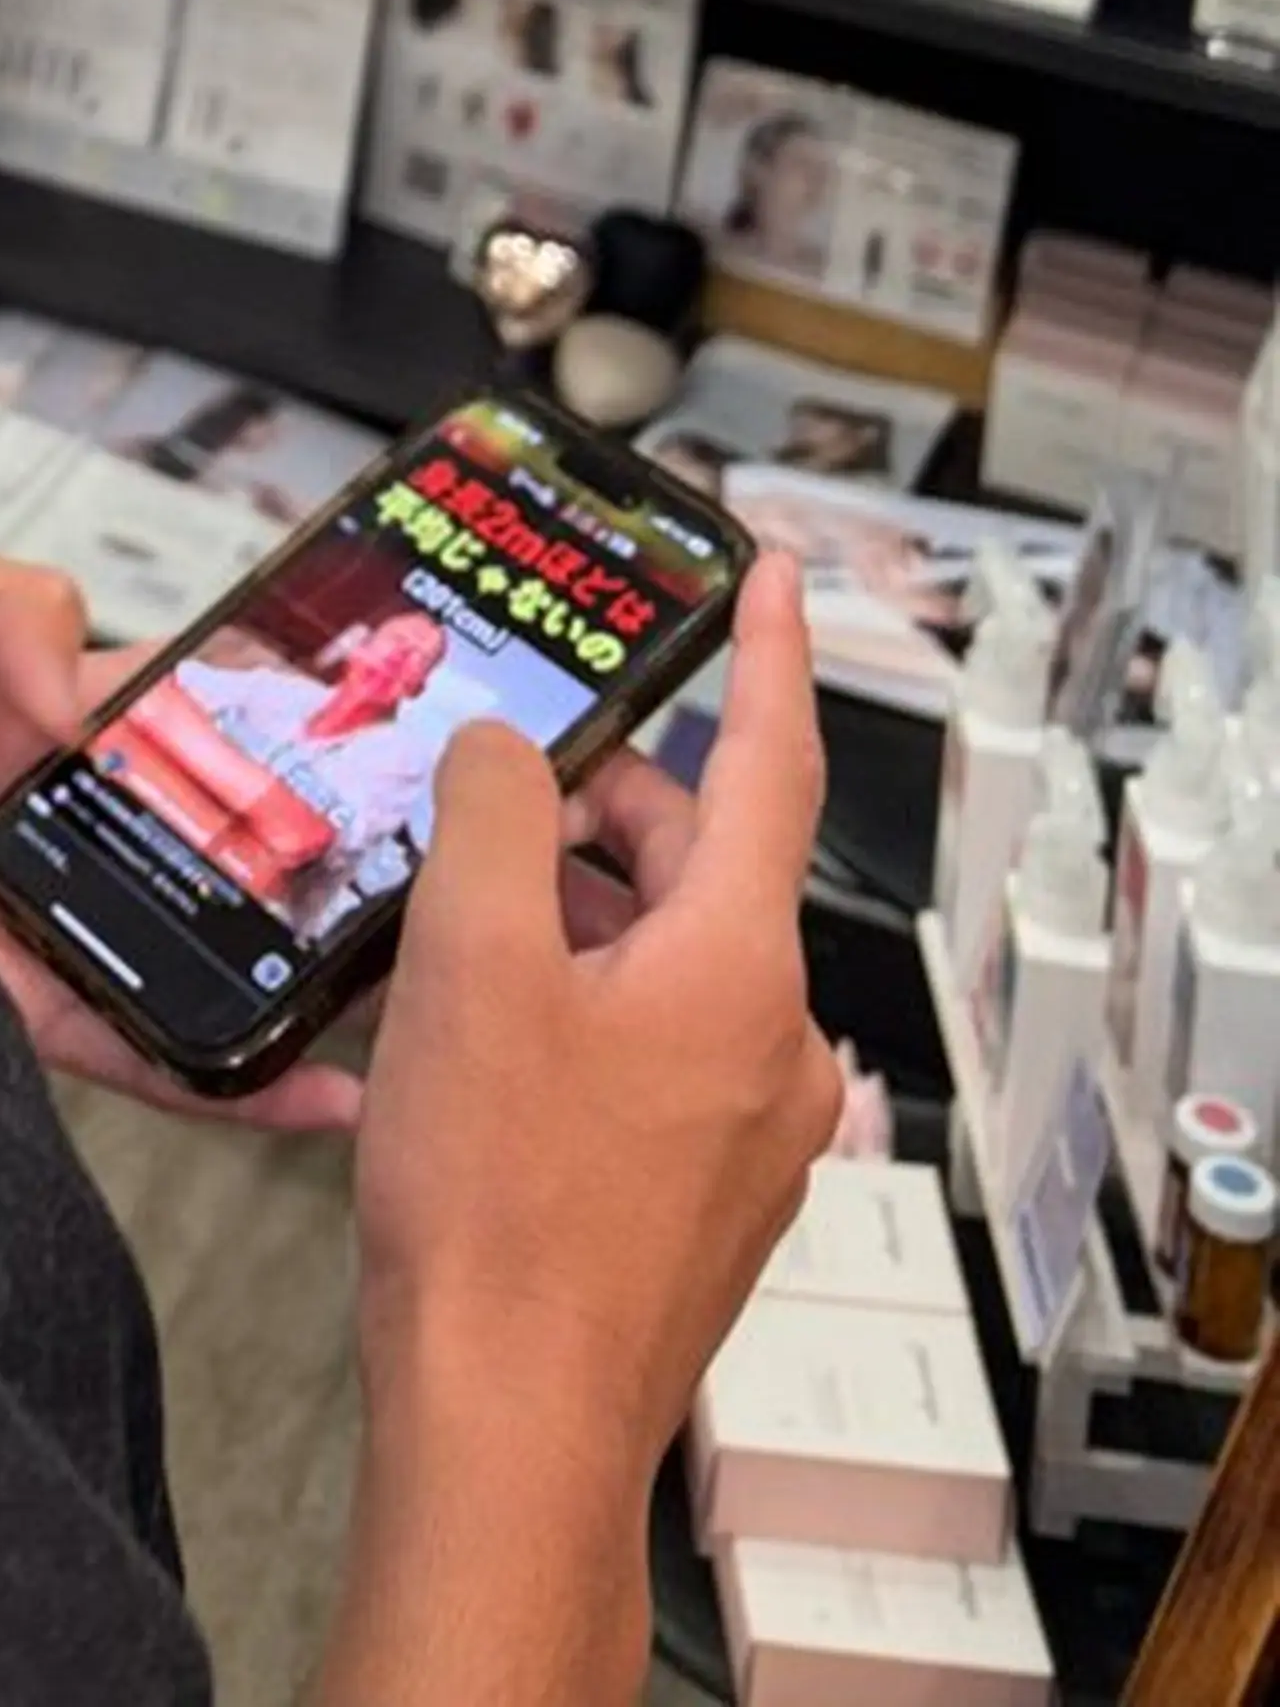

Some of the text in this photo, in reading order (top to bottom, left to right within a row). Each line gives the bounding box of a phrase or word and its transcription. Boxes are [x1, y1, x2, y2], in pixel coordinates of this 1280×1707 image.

[374, 482, 625, 673] 平均じゃないの
[407, 458, 657, 636] 身長2mほどは
